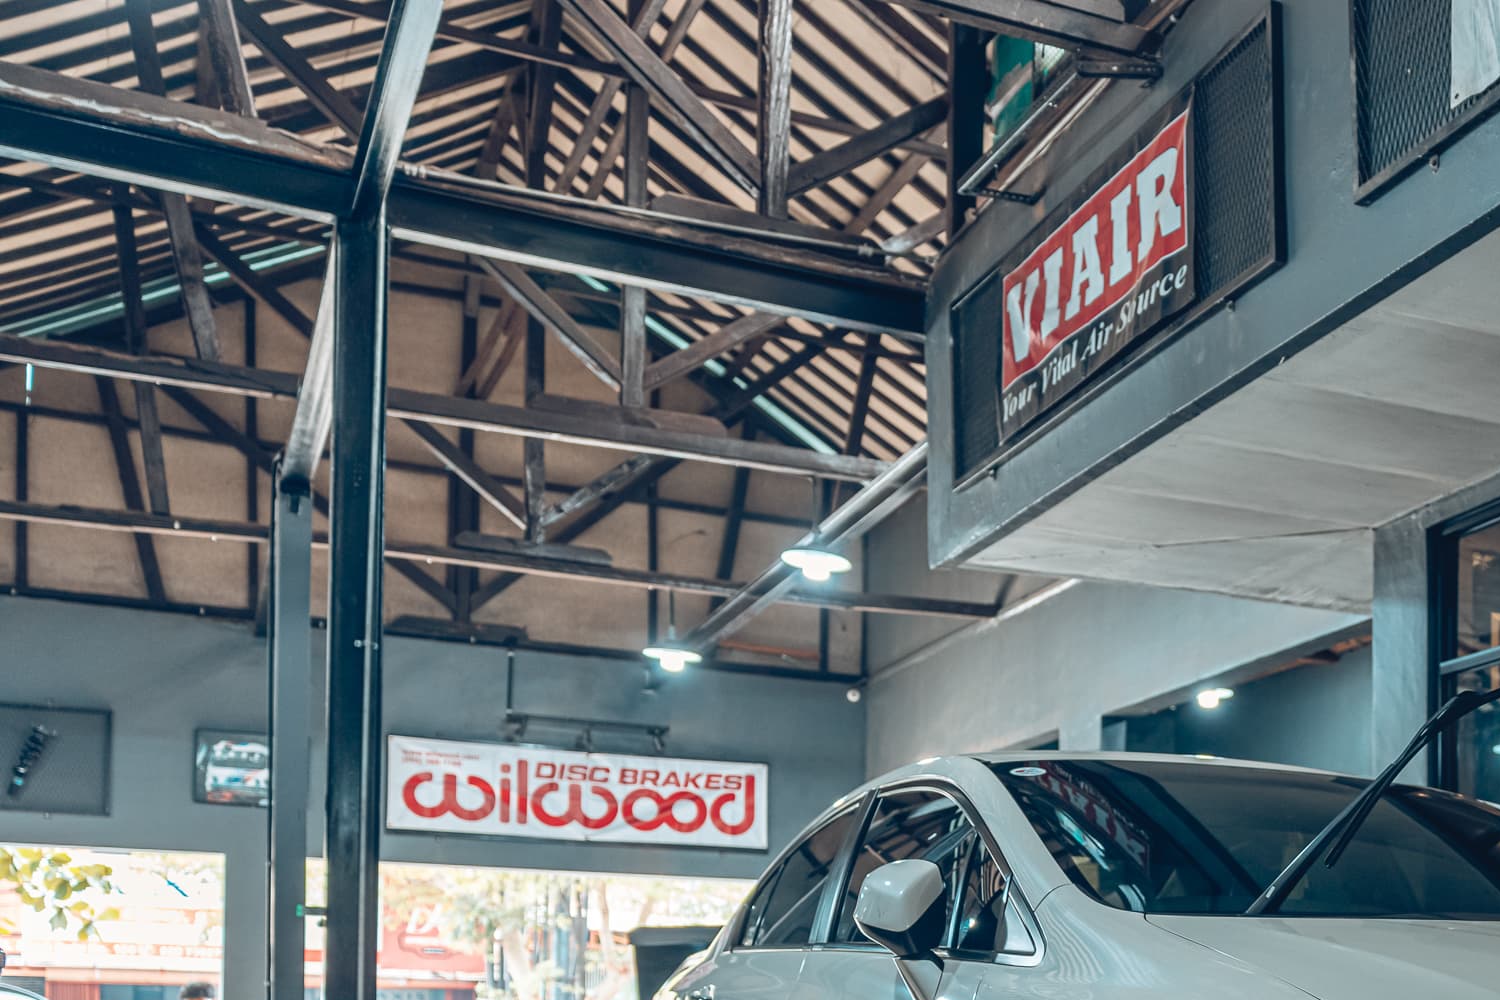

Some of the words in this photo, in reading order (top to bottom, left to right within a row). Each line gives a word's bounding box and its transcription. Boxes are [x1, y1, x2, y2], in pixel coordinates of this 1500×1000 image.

[1007, 147, 1181, 363] VIAIR
[1003, 381, 1037, 422] Your
[1042, 339, 1078, 394] Vital
[1080, 322, 1114, 361] Air
[402, 759, 755, 835] wilwood
[535, 762, 610, 783] DISC
[618, 768, 743, 790] BRAKES
